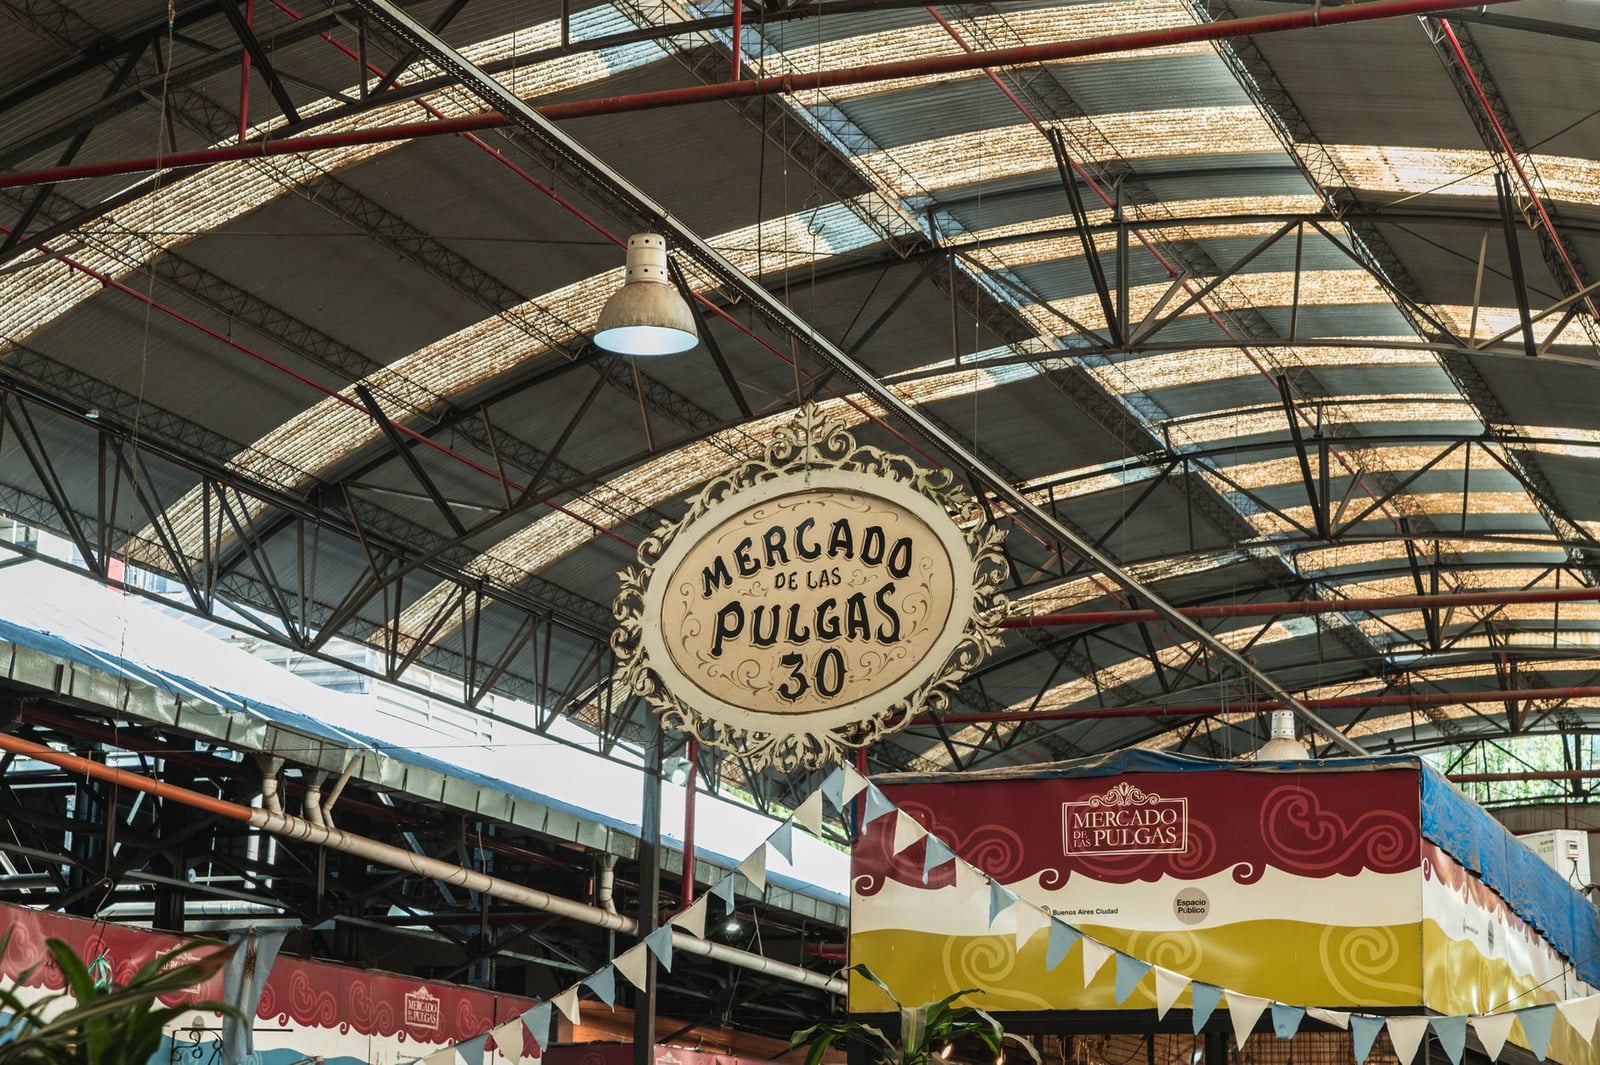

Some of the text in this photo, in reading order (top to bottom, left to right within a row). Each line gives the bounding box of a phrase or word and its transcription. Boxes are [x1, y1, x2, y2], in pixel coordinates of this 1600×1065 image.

[702, 517, 913, 599] MERCADO
[774, 567, 842, 590] DE LAS
[710, 582, 902, 658] PULGAS
[777, 646, 848, 702] 30
[1073, 808, 1177, 829] MERCADO
[1073, 830, 1088, 839] DE
[1073, 826, 1177, 848] LAS PULGAS
[1095, 907, 1119, 915] Ciudad
[1176, 898, 1207, 907] Espacio
[407, 999, 437, 1013] MERCADO
[413, 1010, 437, 1024] PULGAS
